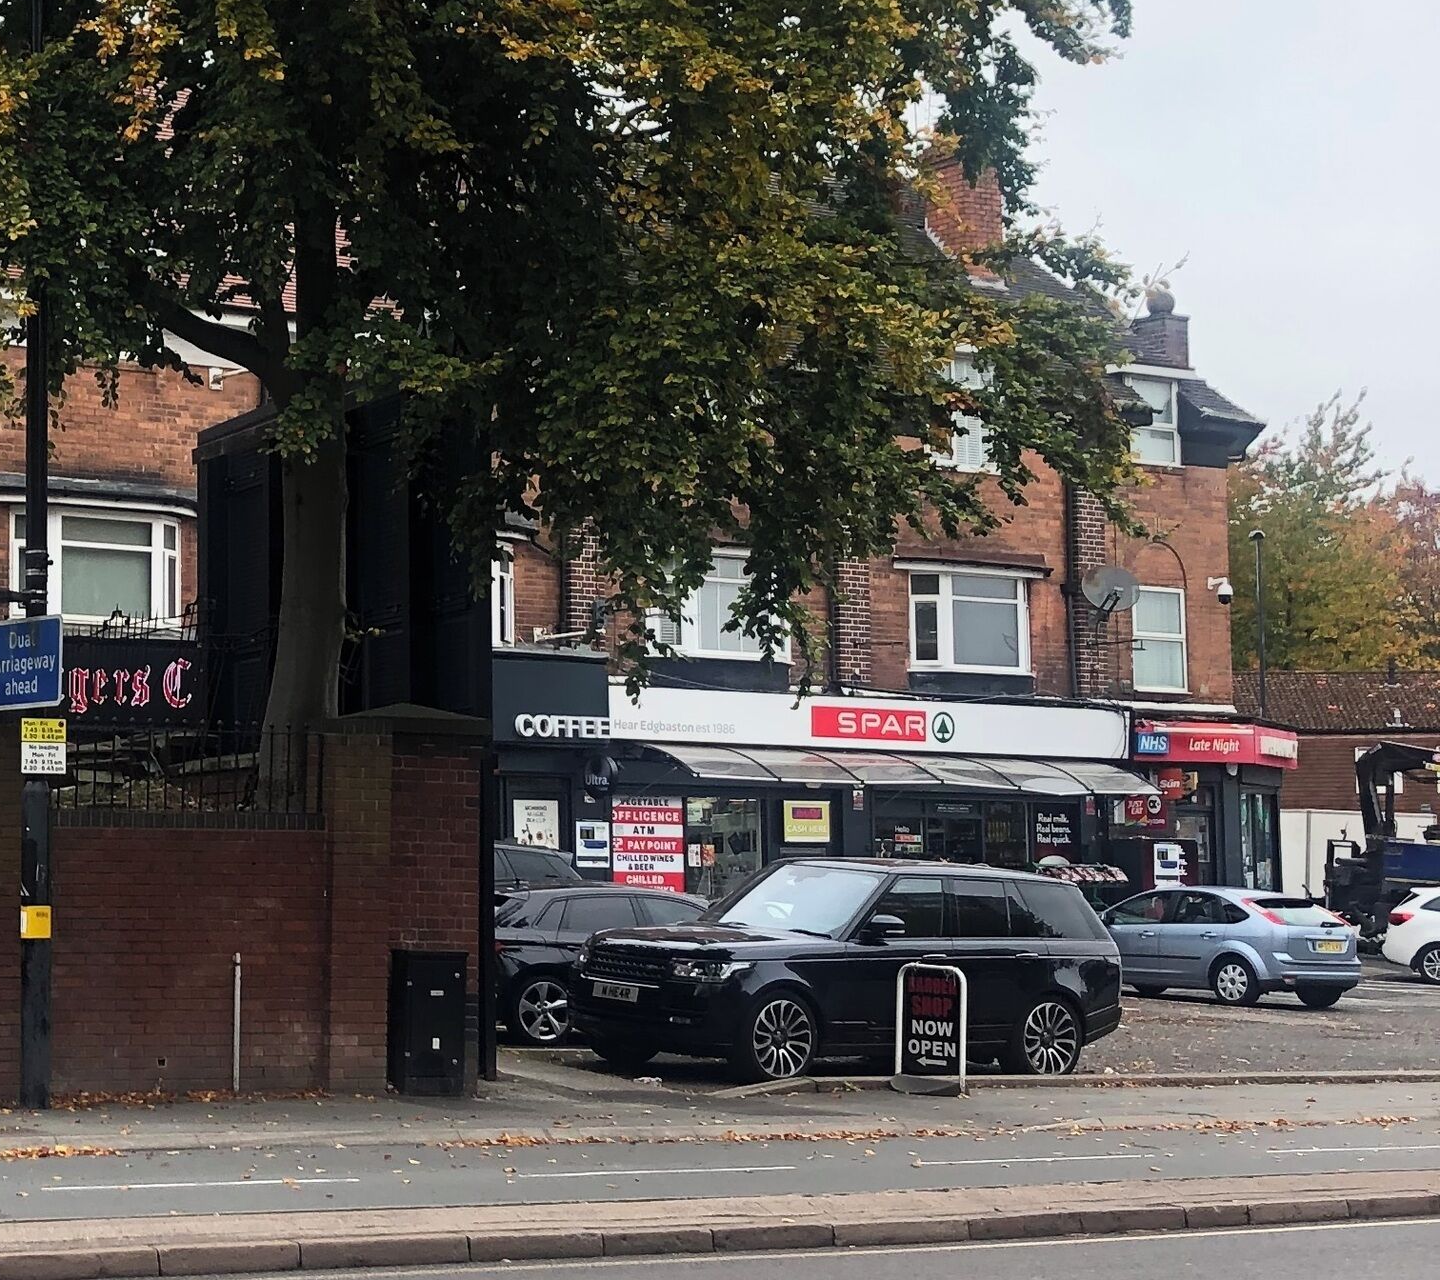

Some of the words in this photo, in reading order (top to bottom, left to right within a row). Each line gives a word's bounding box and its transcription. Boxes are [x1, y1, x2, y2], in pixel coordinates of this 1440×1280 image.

[5, 677, 38, 695] ahead
[515, 713, 610, 738] COFFEE
[613, 719, 637, 731] Hear
[640, 720, 695, 734] Edgbaston
[695, 724, 711, 734] est
[713, 723, 736, 735] 1986
[837, 711, 925, 737] SPAR
[1140, 735, 1168, 751] NHS
[1189, 738, 1211, 752] Late
[1212, 737, 1240, 755] Night
[633, 811, 680, 822] LICENCE
[1037, 813, 1052, 823] Real
[633, 825, 655, 835] ATM
[786, 825, 807, 833] CASH
[808, 825, 828, 833] HERE
[1036, 823, 1051, 833] Real
[1037, 833, 1052, 844] Real
[627, 840, 647, 850] PAY
[647, 841, 677, 851] POINT
[617, 854, 649, 862] CHILLED
[626, 875, 664, 884] CHILLED
[912, 994, 953, 1018] SHOP
[912, 1019, 953, 1037] NOW
[908, 1039, 956, 1058] OPEN
